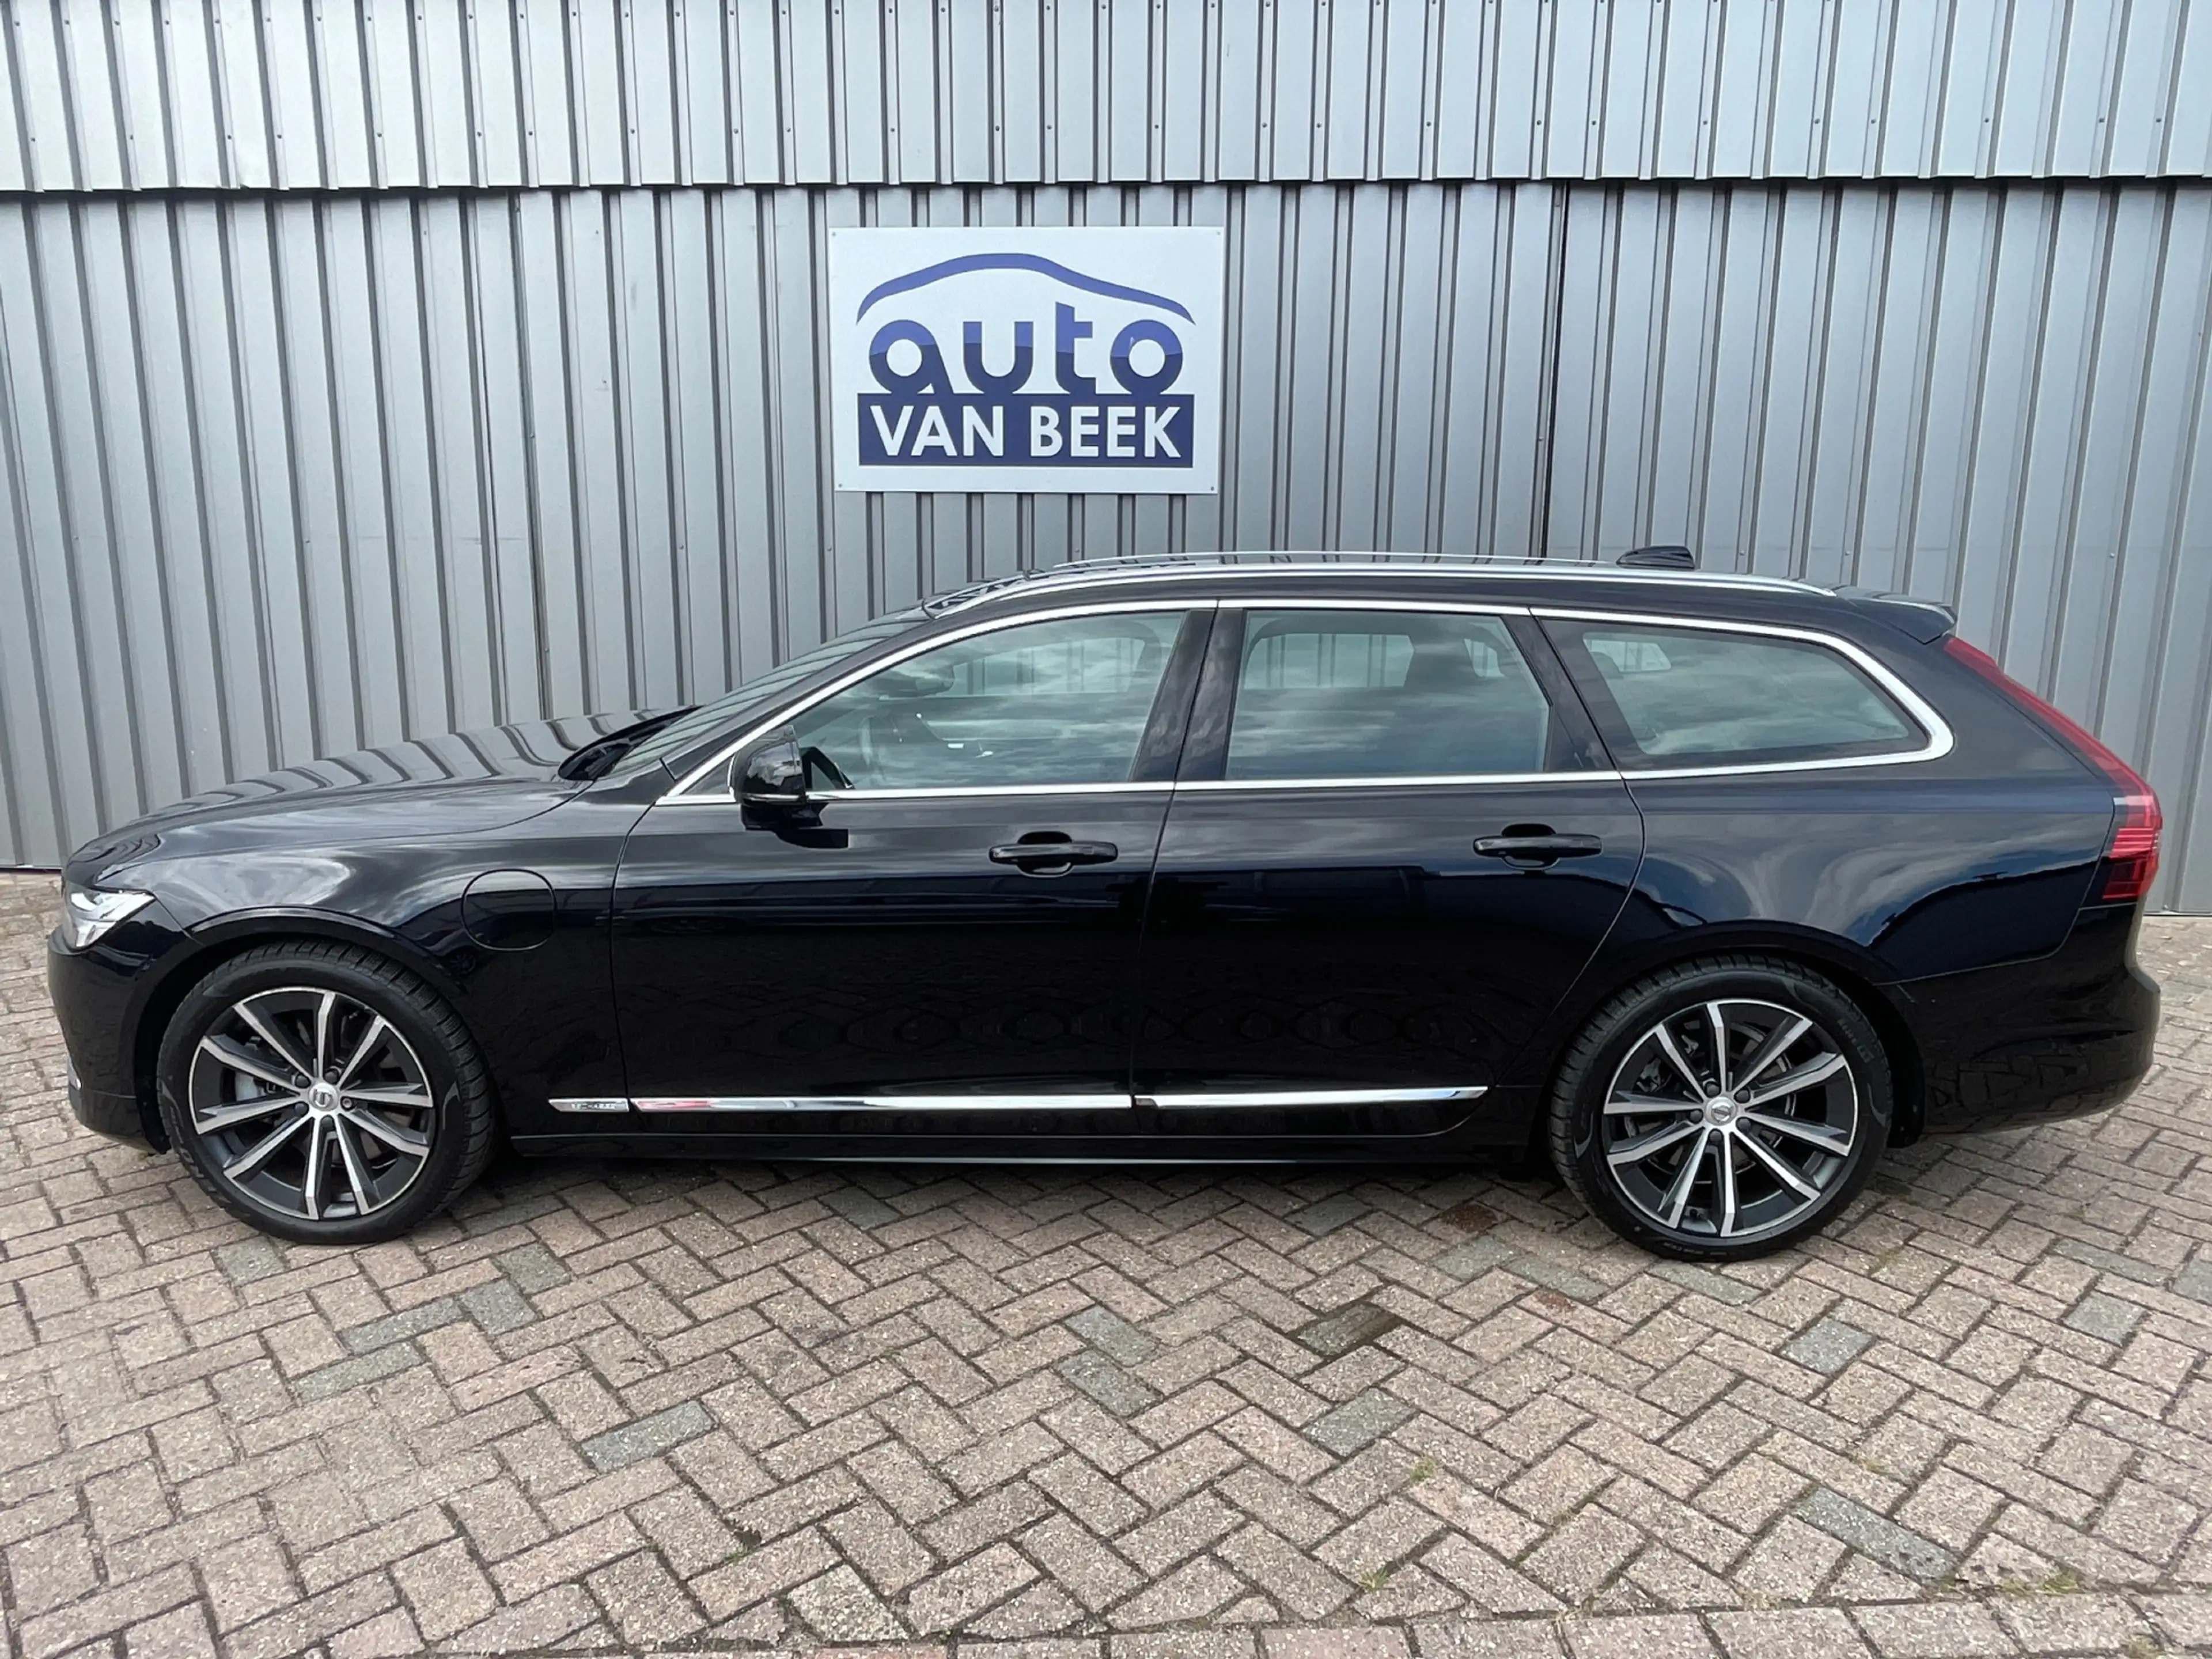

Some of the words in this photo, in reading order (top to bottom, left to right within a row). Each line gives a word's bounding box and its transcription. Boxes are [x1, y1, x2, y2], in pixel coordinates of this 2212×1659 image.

[869, 301, 1183, 395] auto
[870, 406, 1005, 457] VAN
[1030, 406, 1181, 458] BEEK
